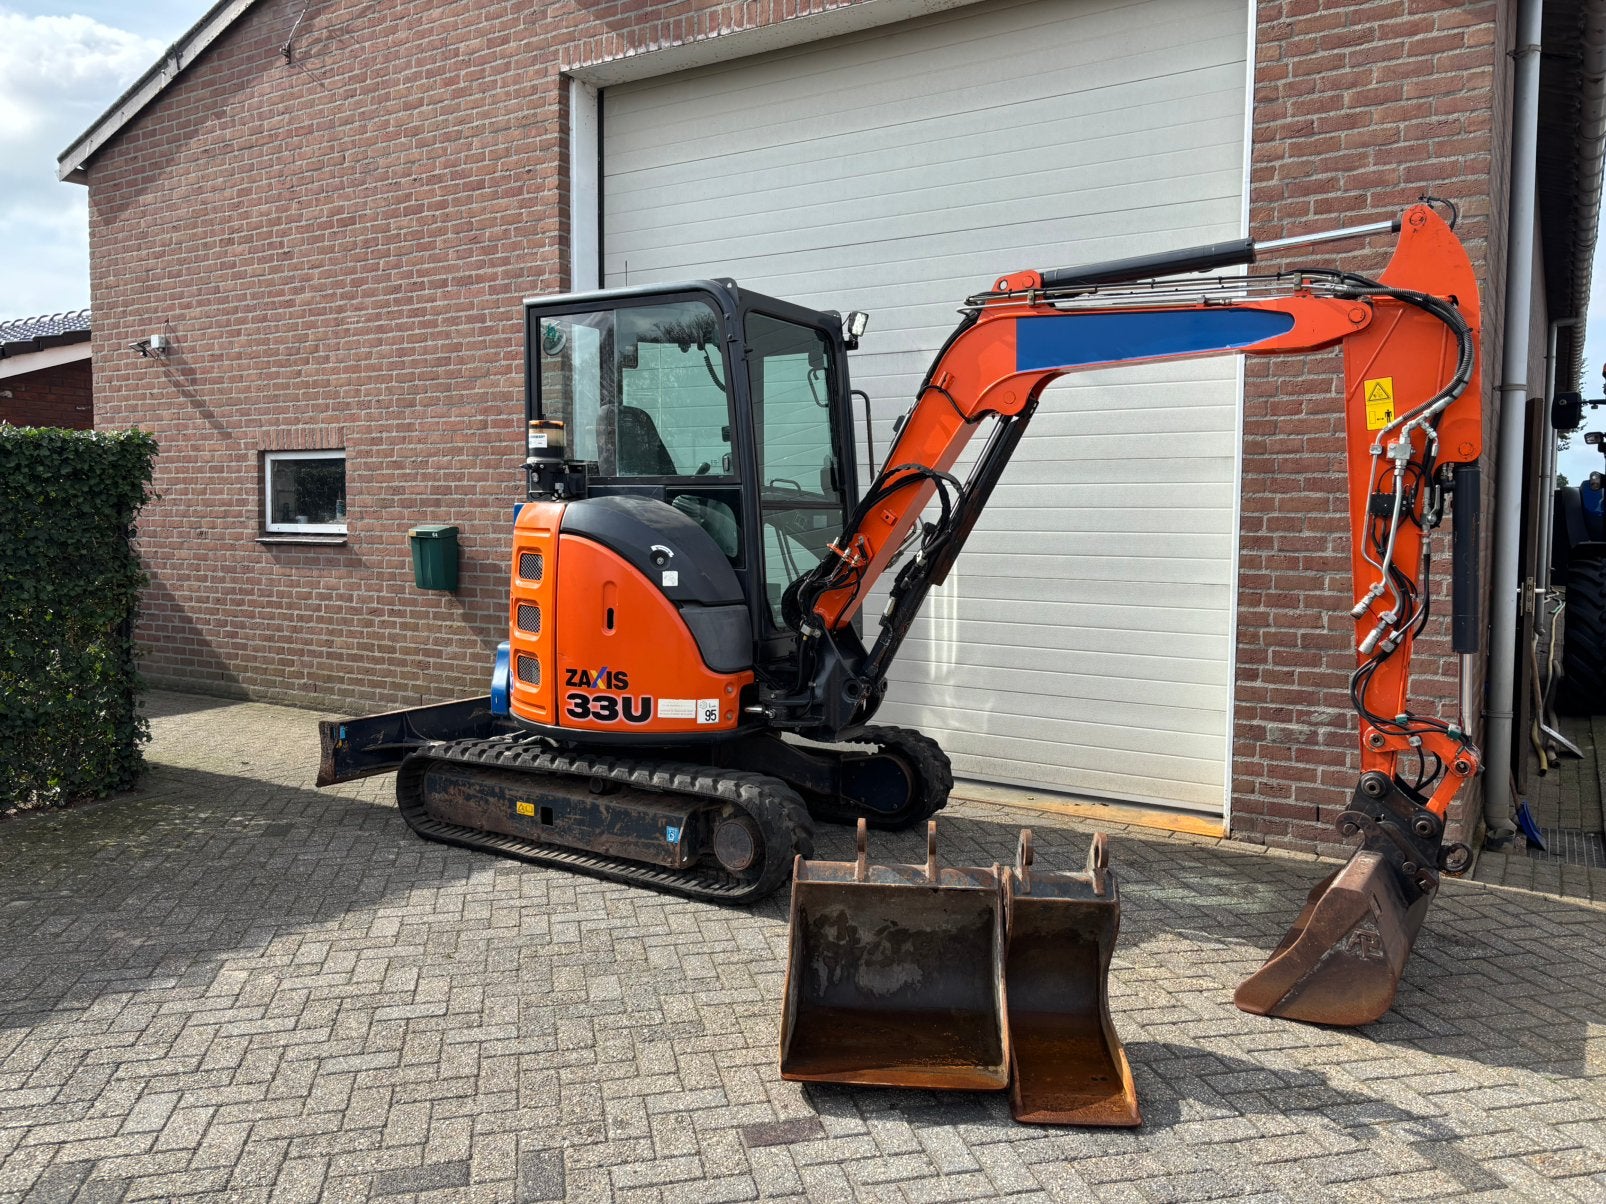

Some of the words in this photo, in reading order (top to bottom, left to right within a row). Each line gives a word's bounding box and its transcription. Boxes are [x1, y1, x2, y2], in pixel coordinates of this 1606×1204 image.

[565, 666, 629, 690] ZAXIS
[566, 692, 652, 724] 33U
[705, 709, 717, 721] 95
